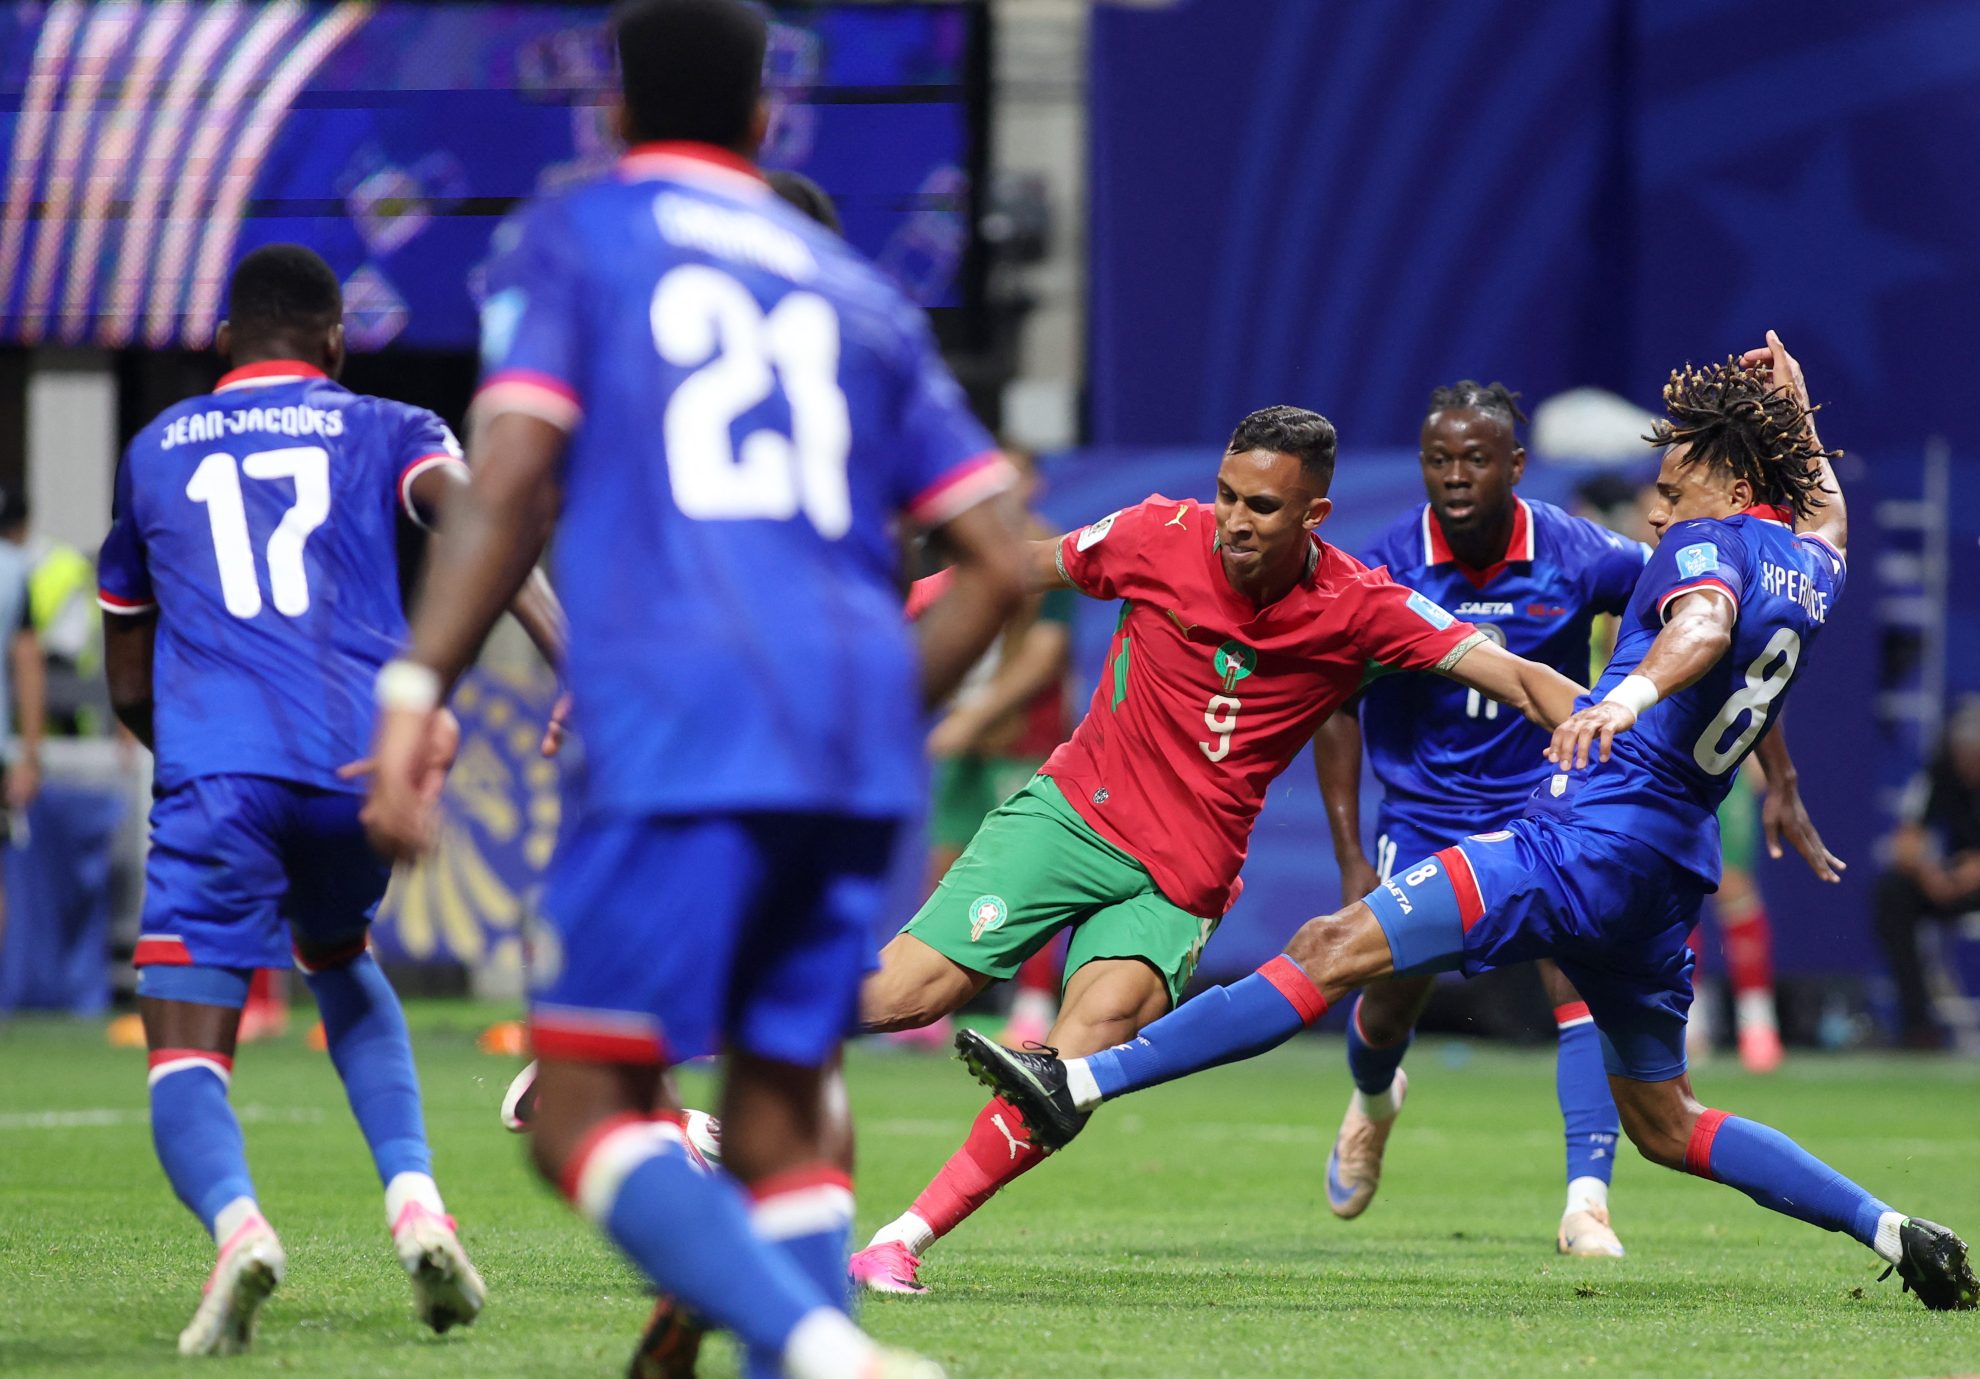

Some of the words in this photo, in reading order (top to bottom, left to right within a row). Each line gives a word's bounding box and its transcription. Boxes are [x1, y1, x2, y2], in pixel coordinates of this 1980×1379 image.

[160, 403, 344, 450] JEAN-JACQUES
[650, 263, 853, 540] 21
[186, 446, 330, 619] 17
[1454, 602, 1514, 615] SAETA
[1199, 694, 1242, 763] 9
[1693, 627, 1801, 776] 8
[1381, 879, 1413, 915] AETA
[1405, 863, 1438, 887] 8
